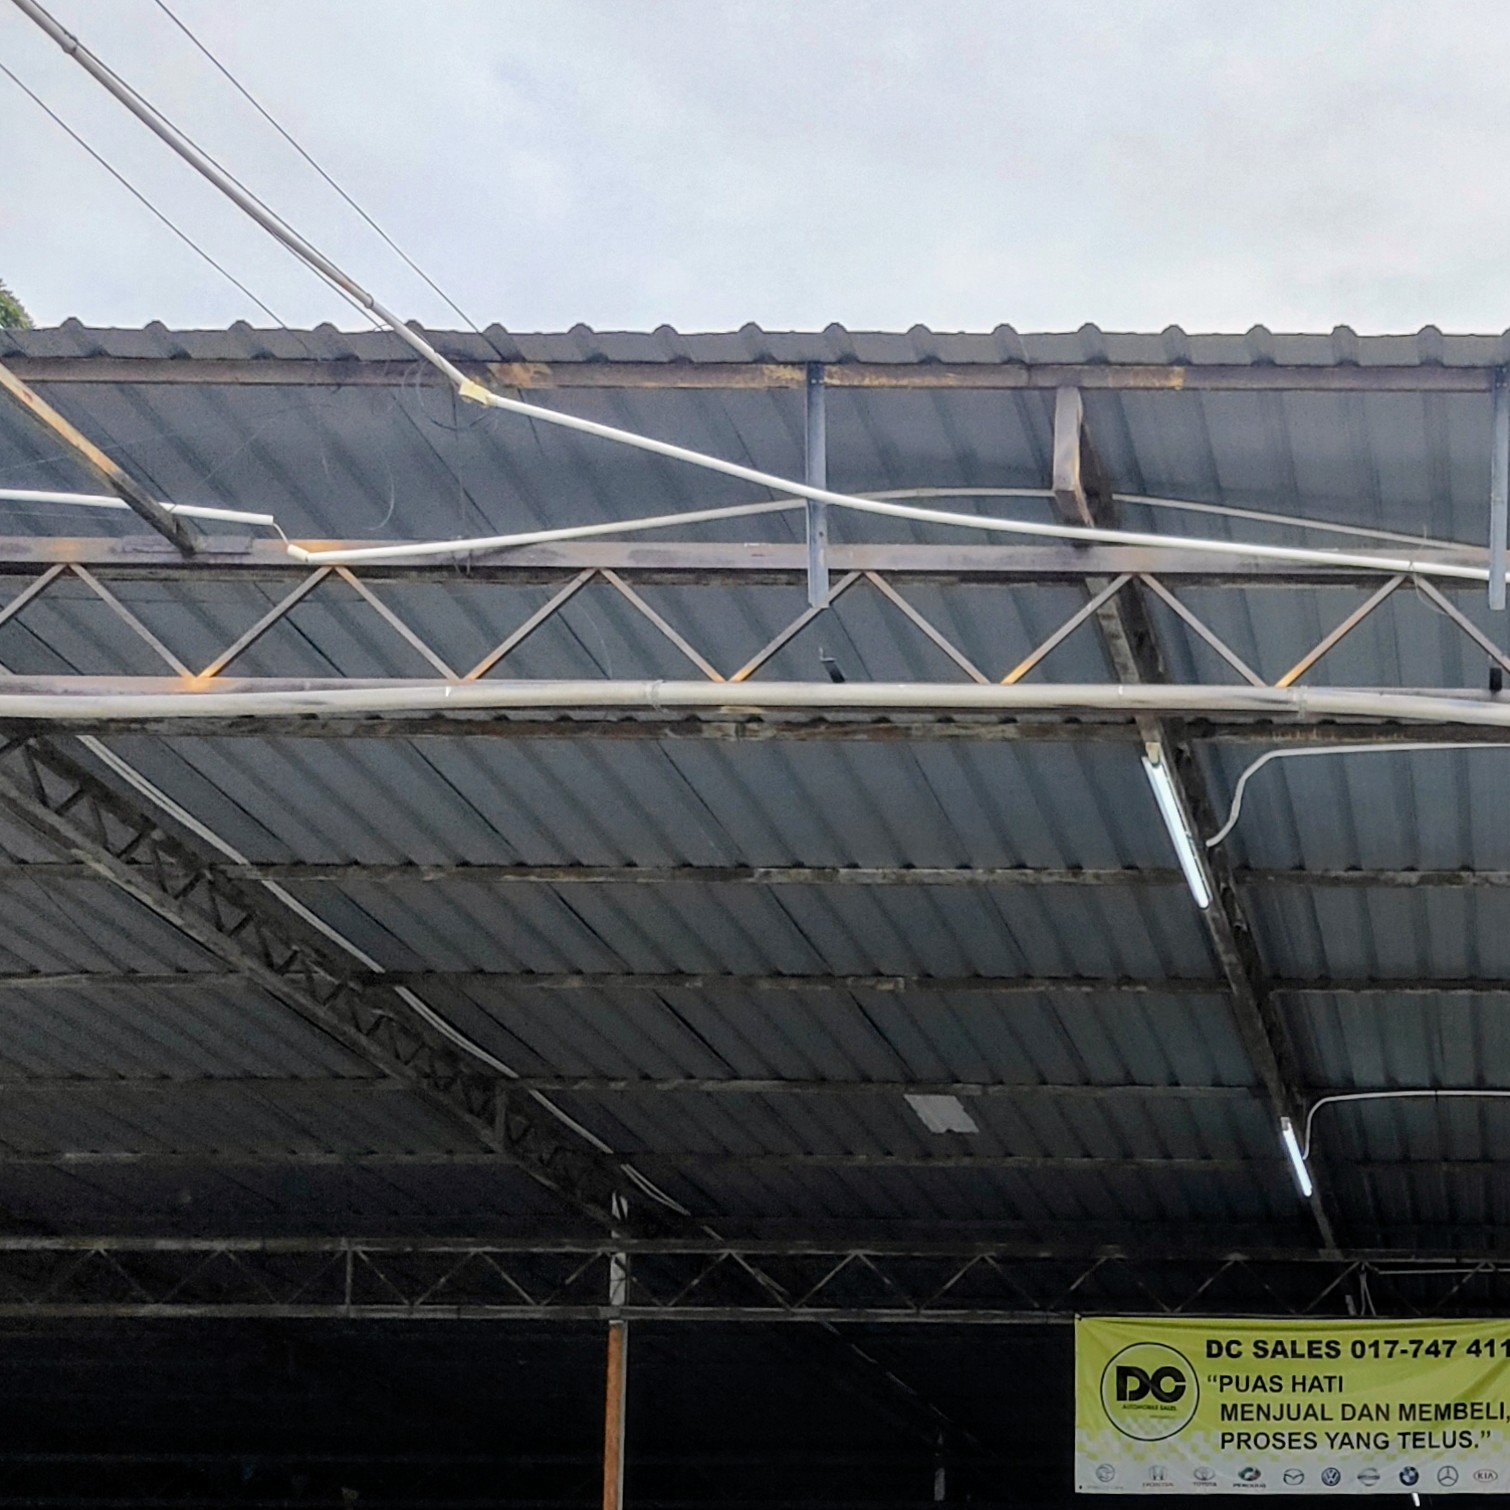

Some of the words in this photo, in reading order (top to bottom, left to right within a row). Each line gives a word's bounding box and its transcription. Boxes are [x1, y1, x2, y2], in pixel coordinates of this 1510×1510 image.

[1206, 1339, 1243, 1358] DC
[1252, 1339, 1341, 1359] SALES
[1351, 1339, 1457, 1359] 017-747
[1116, 1366, 1186, 1403] DC
[1291, 1375, 1343, 1393] HATI
[1220, 1403, 1334, 1421] MENJUAL
[1341, 1403, 1390, 1422] DAN
[1399, 1402, 1510, 1423] MEMBELI,
[1221, 1432, 1317, 1450] PROSES
[1325, 1432, 1389, 1450] YANG
